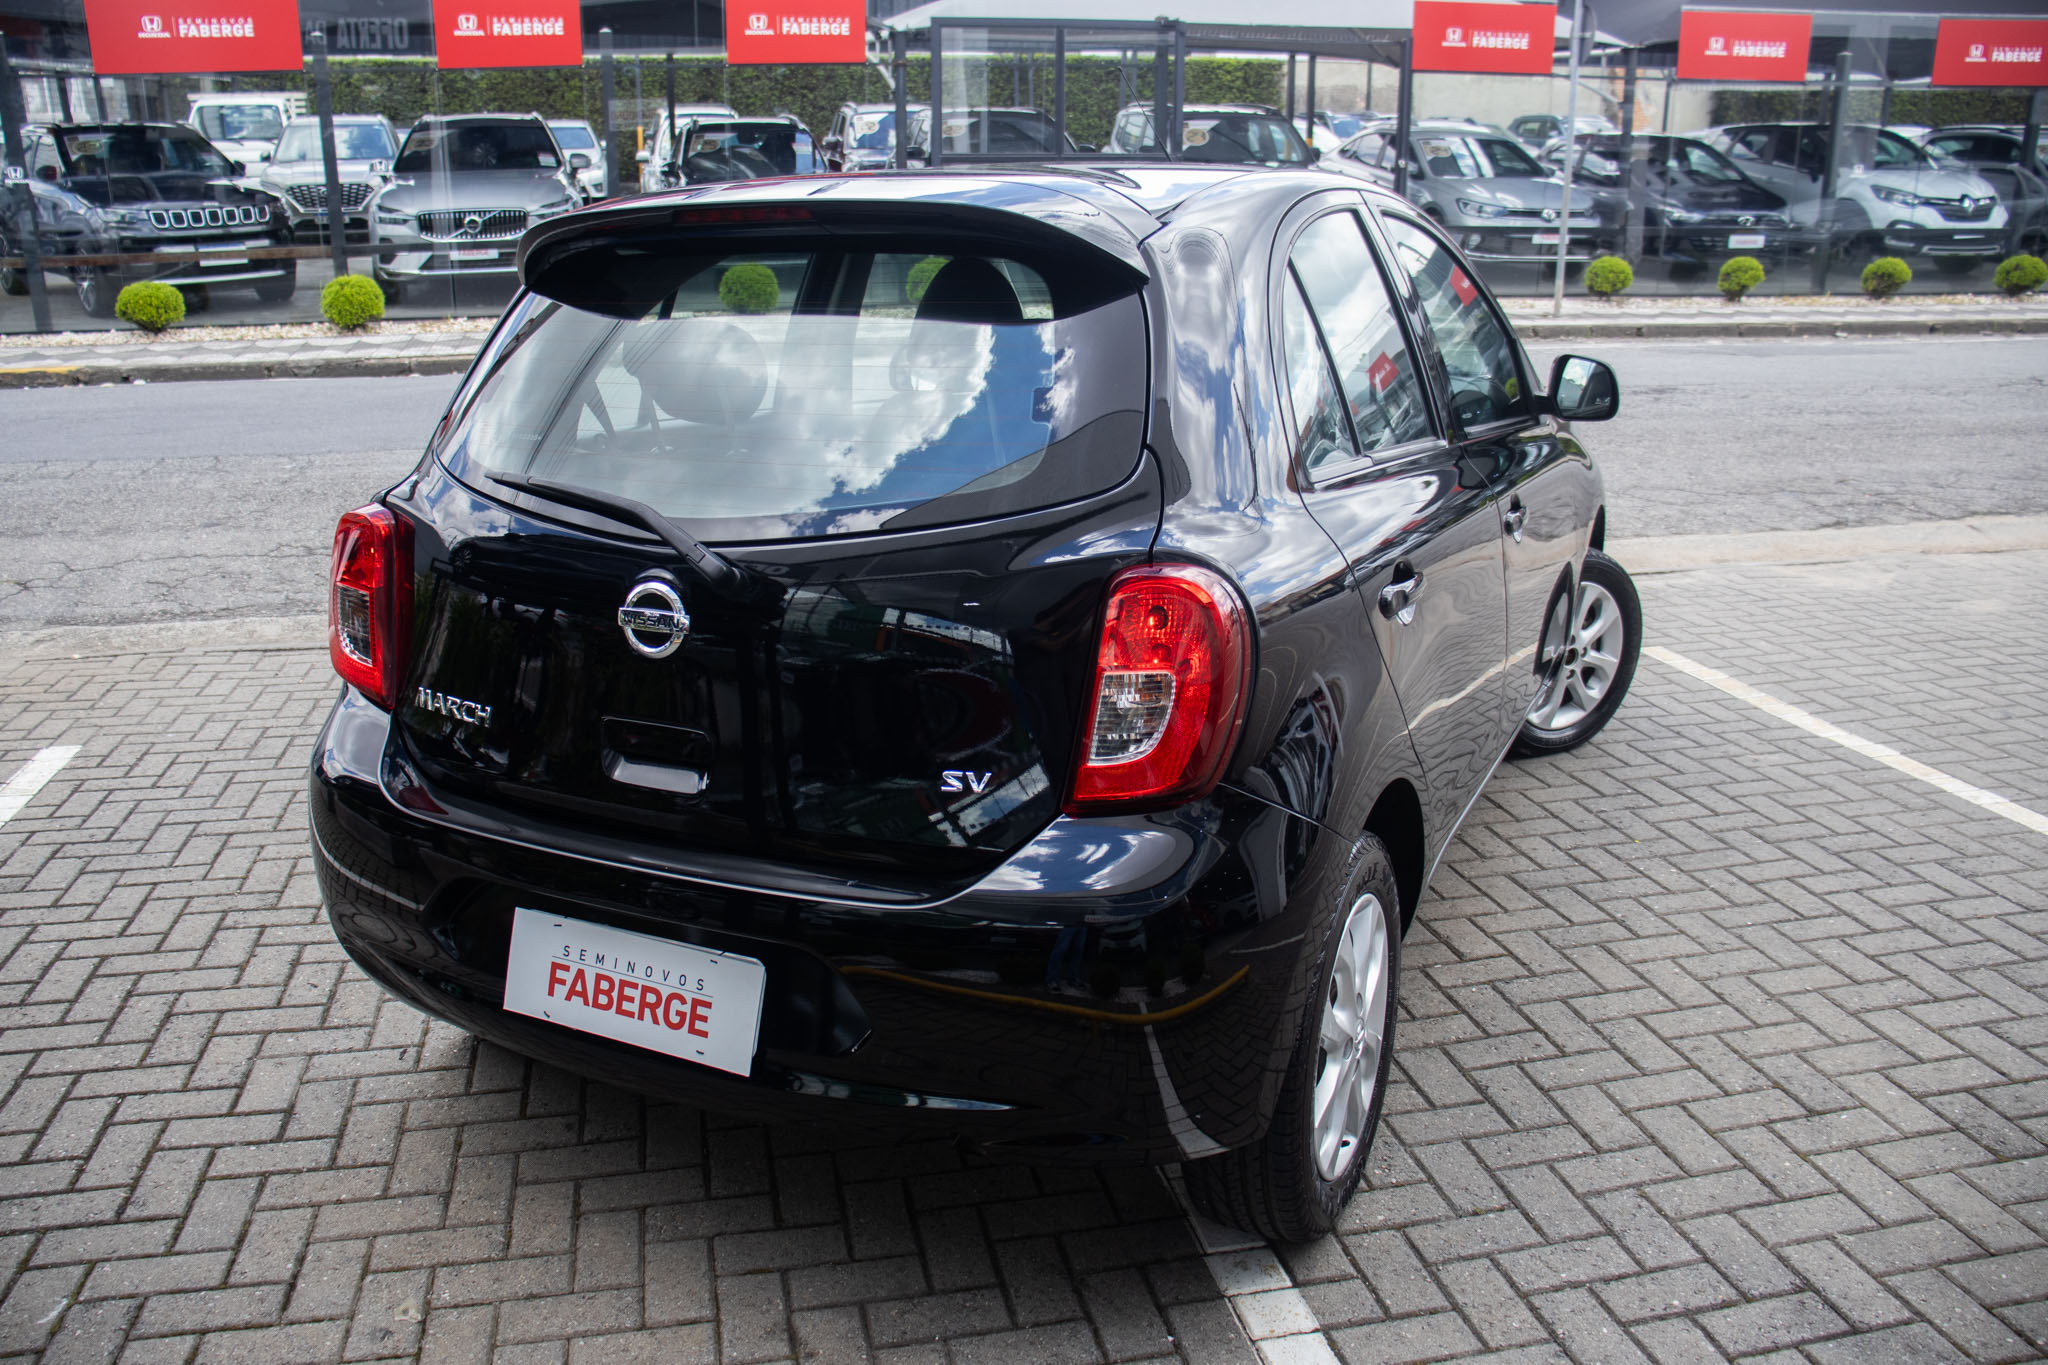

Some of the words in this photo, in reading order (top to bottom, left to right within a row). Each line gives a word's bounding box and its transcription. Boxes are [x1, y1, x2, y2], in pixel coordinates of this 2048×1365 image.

[179, 24, 255, 38] FABERGE
[492, 22, 565, 36] FABERGE
[782, 22, 851, 35] FABERGE
[1472, 36, 1529, 50] FABERGE
[1732, 46, 1786, 58] FABERGE
[1991, 51, 2042, 62] FABERGE
[622, 610, 682, 631] NISSAN
[414, 686, 491, 728] MARCH
[940, 770, 992, 793] SV
[562, 944, 705, 991] SEMINOVOS
[547, 961, 713, 1039] FABERGE
